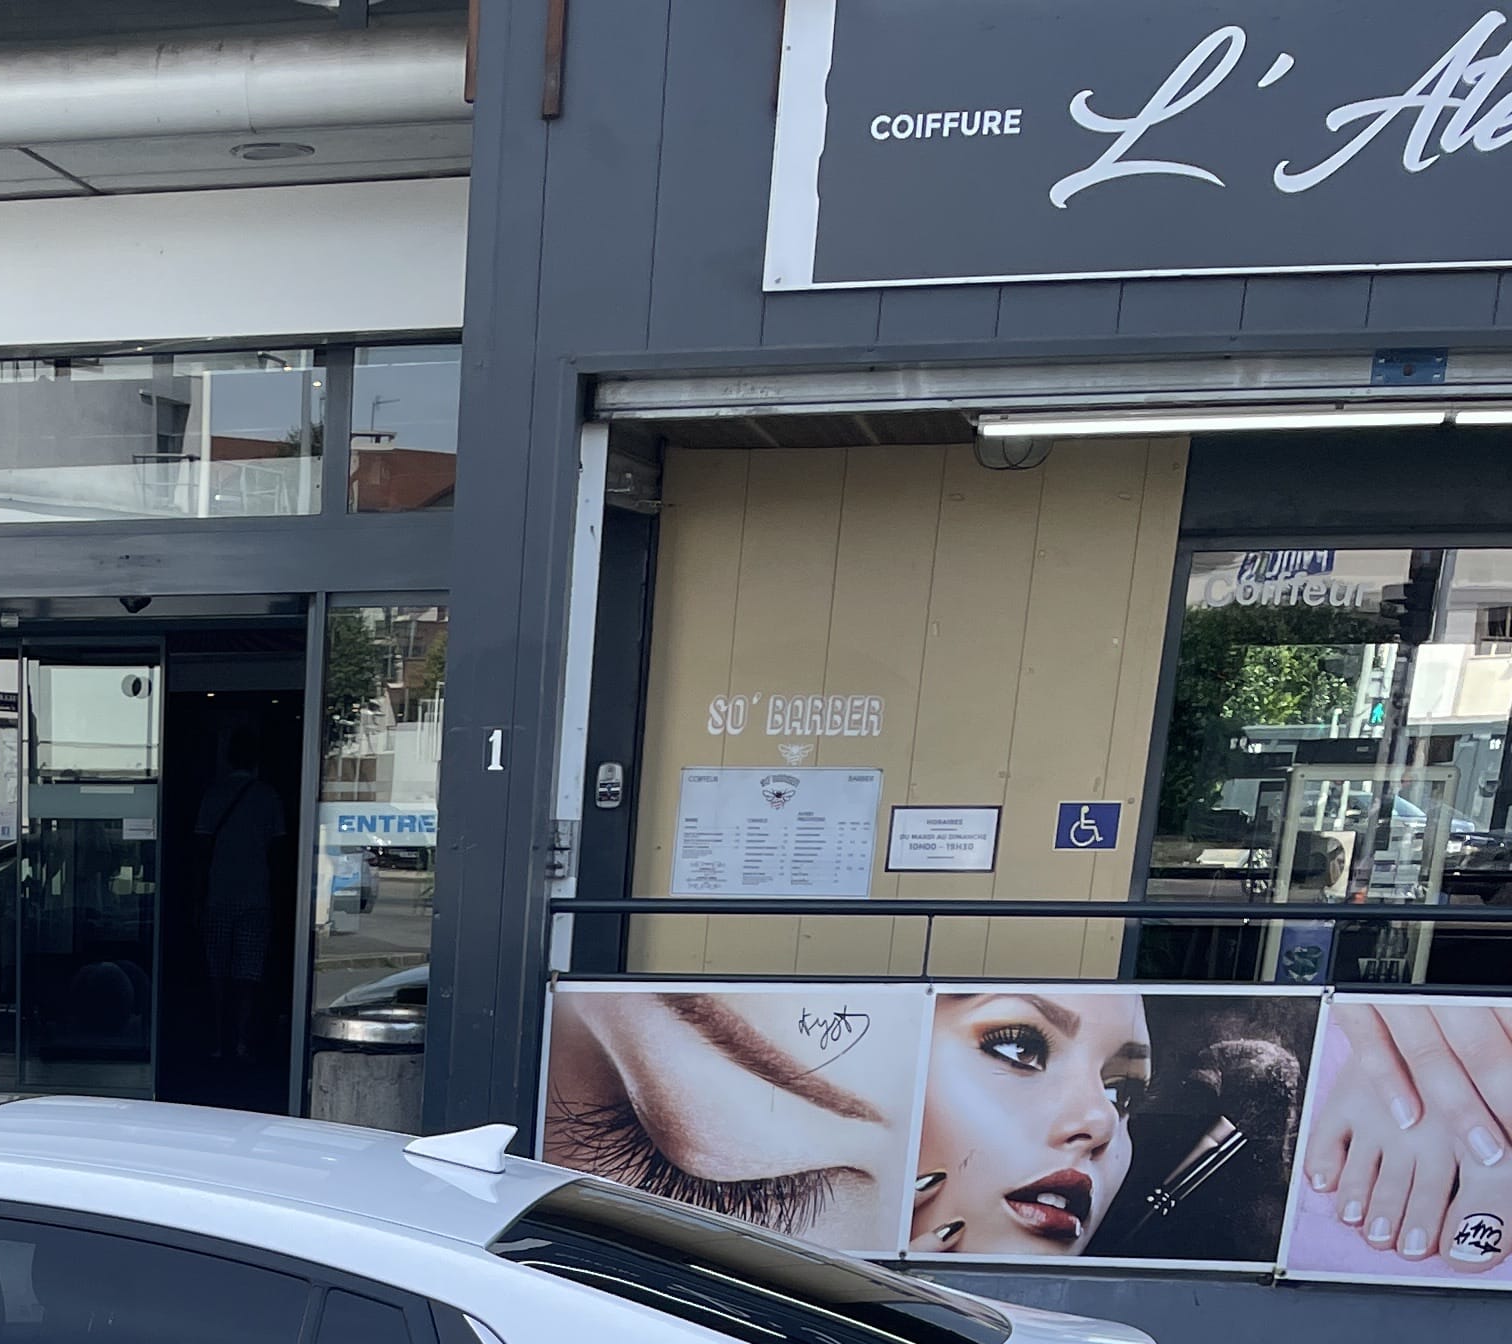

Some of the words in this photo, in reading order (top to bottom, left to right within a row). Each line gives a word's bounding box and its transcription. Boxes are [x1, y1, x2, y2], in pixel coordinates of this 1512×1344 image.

[870, 109, 1022, 141] COIFFURE
[1049, 26, 1295, 209] L'
[1204, 572, 1369, 608] Coiffeur
[765, 694, 886, 737] BARBER
[487, 728, 505, 771] 1
[911, 833, 935, 841] MARDI
[936, 833, 947, 841] AU
[948, 833, 987, 841] DIMANCHE
